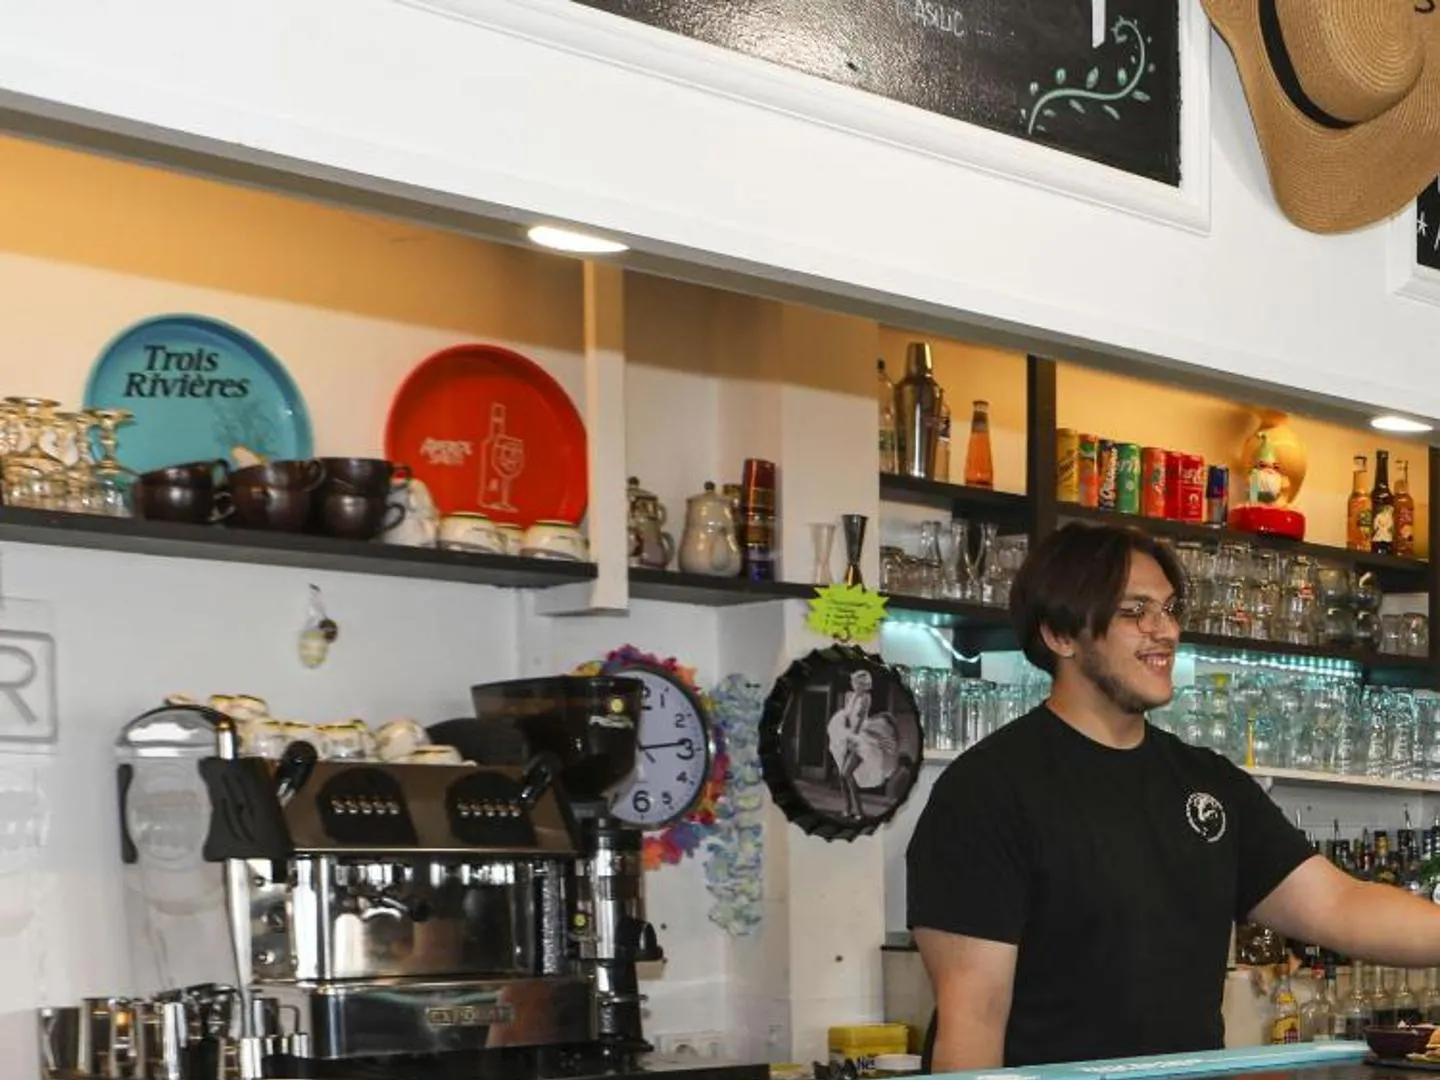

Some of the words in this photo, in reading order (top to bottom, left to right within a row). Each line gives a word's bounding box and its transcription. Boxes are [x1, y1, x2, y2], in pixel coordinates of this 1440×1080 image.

[143, 344, 220, 373] Trois
[122, 371, 252, 399] Rivières
[676, 737, 695, 761] 3
[632, 789, 652, 813] 6
